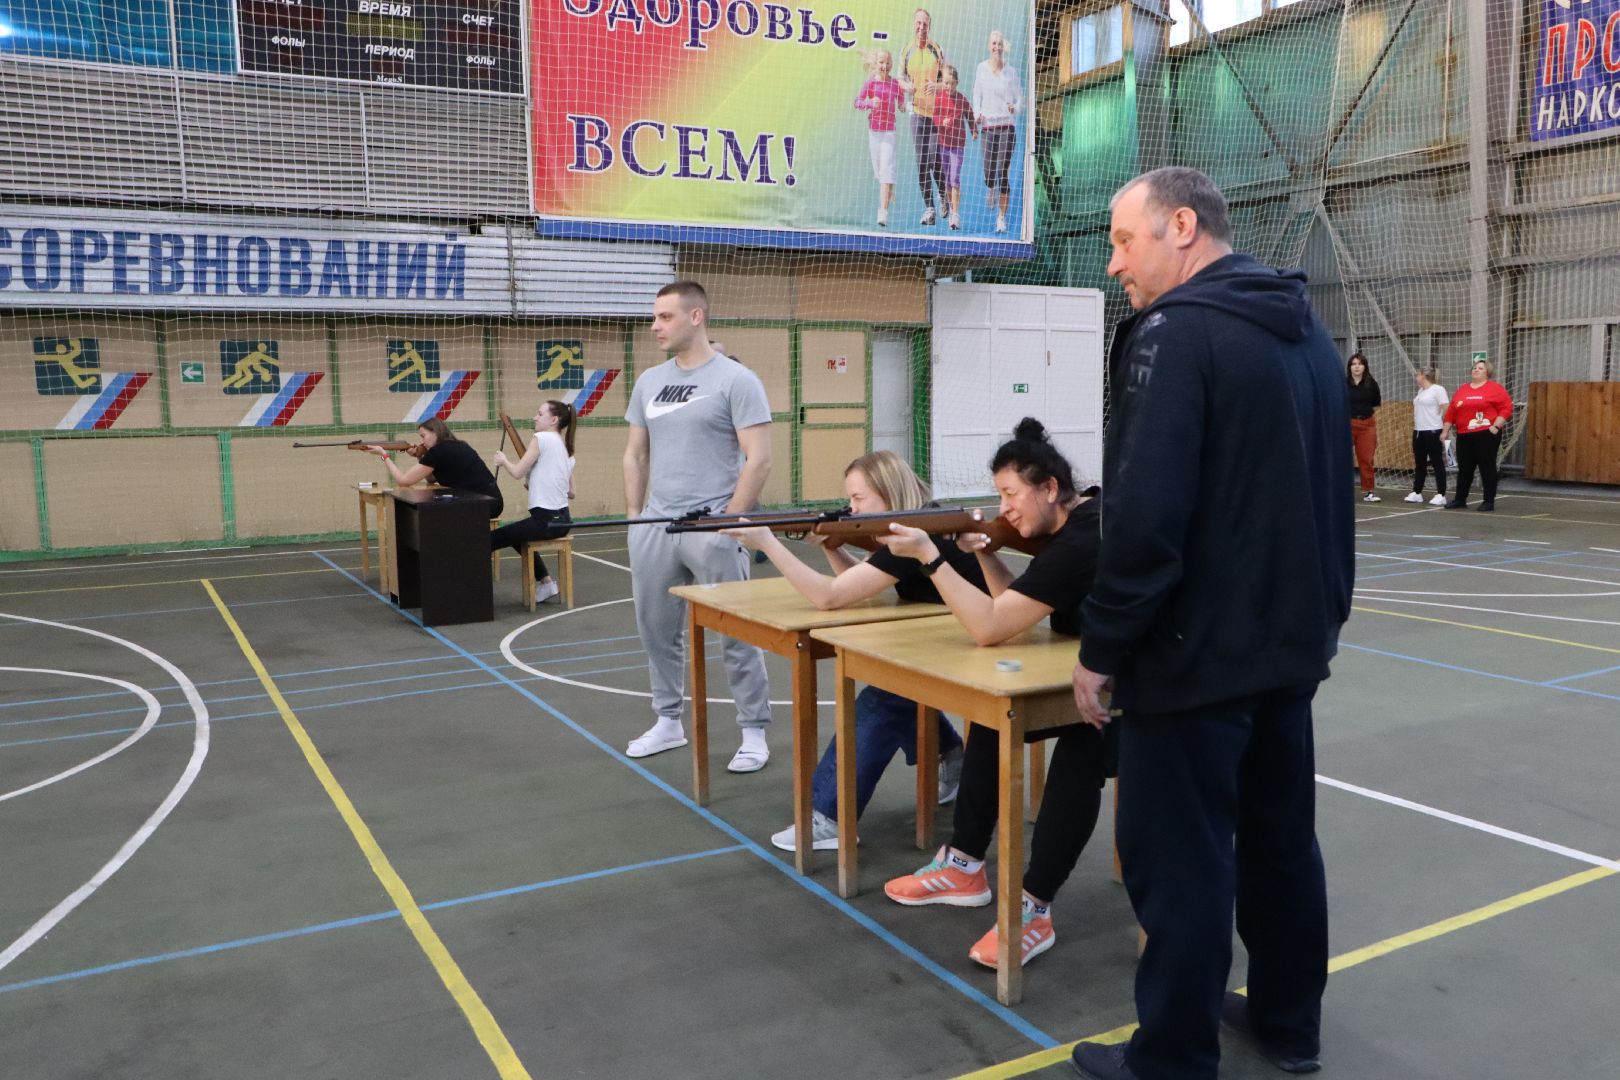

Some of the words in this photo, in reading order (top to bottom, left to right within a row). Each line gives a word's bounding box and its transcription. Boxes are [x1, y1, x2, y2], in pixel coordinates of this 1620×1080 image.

[359, 1, 411, 18] ВРЕМЯ
[462, 13, 495, 27] СЧЕТ
[271, 36, 306, 48] ФОЛЫ
[365, 44, 415, 60] ПЕРИОД
[466, 55, 497, 67] ФОЛЫ
[566, 113, 798, 187] ВСЕМ!
[655, 384, 698, 403] NIKE
